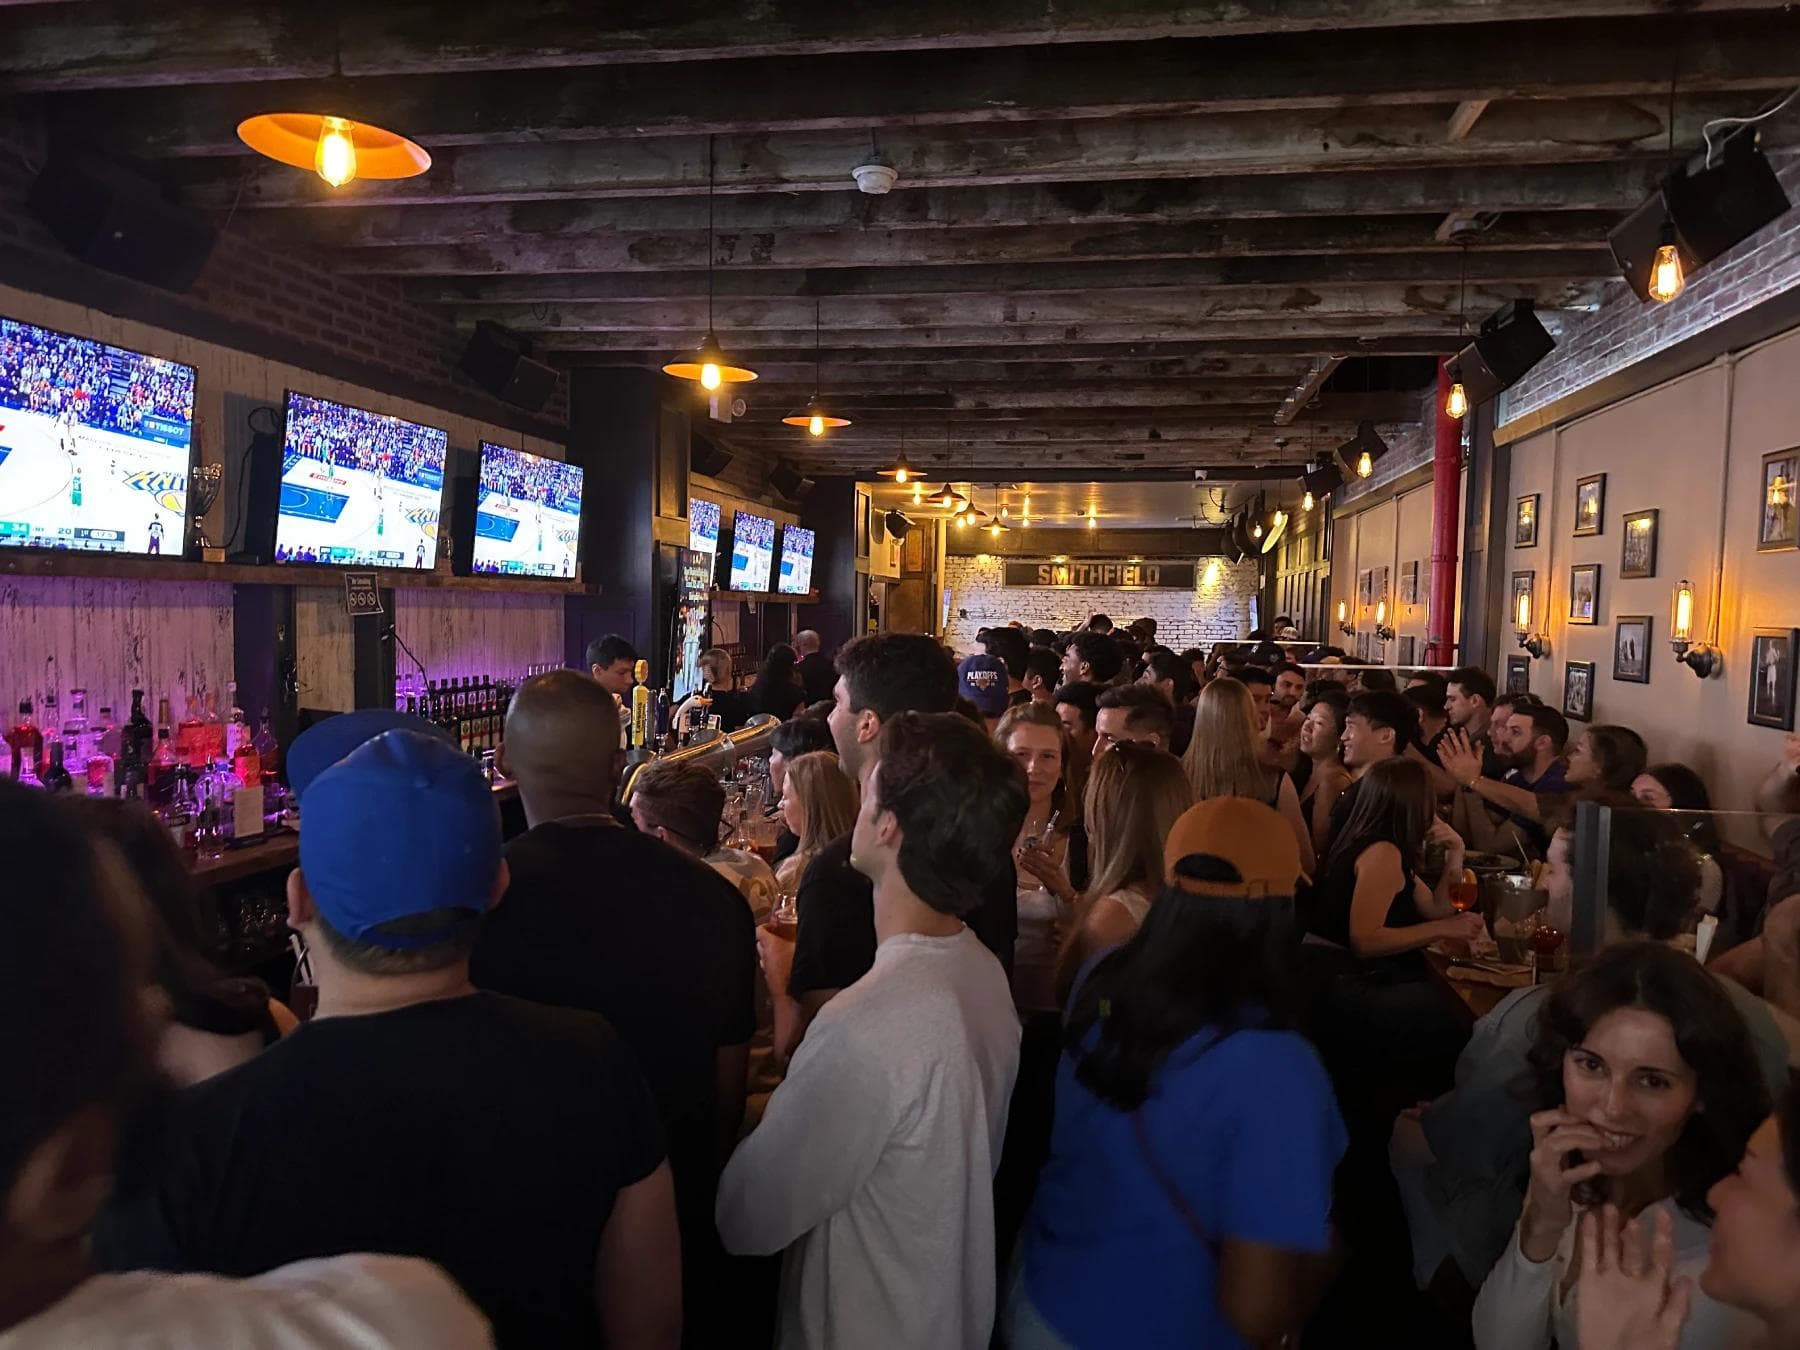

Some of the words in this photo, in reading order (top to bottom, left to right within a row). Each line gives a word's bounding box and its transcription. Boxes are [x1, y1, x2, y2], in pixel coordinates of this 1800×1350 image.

[57, 527, 72, 536] 20
[1038, 565, 1160, 585] SMITHFIELD
[967, 670, 998, 680] PLAYOFFS
